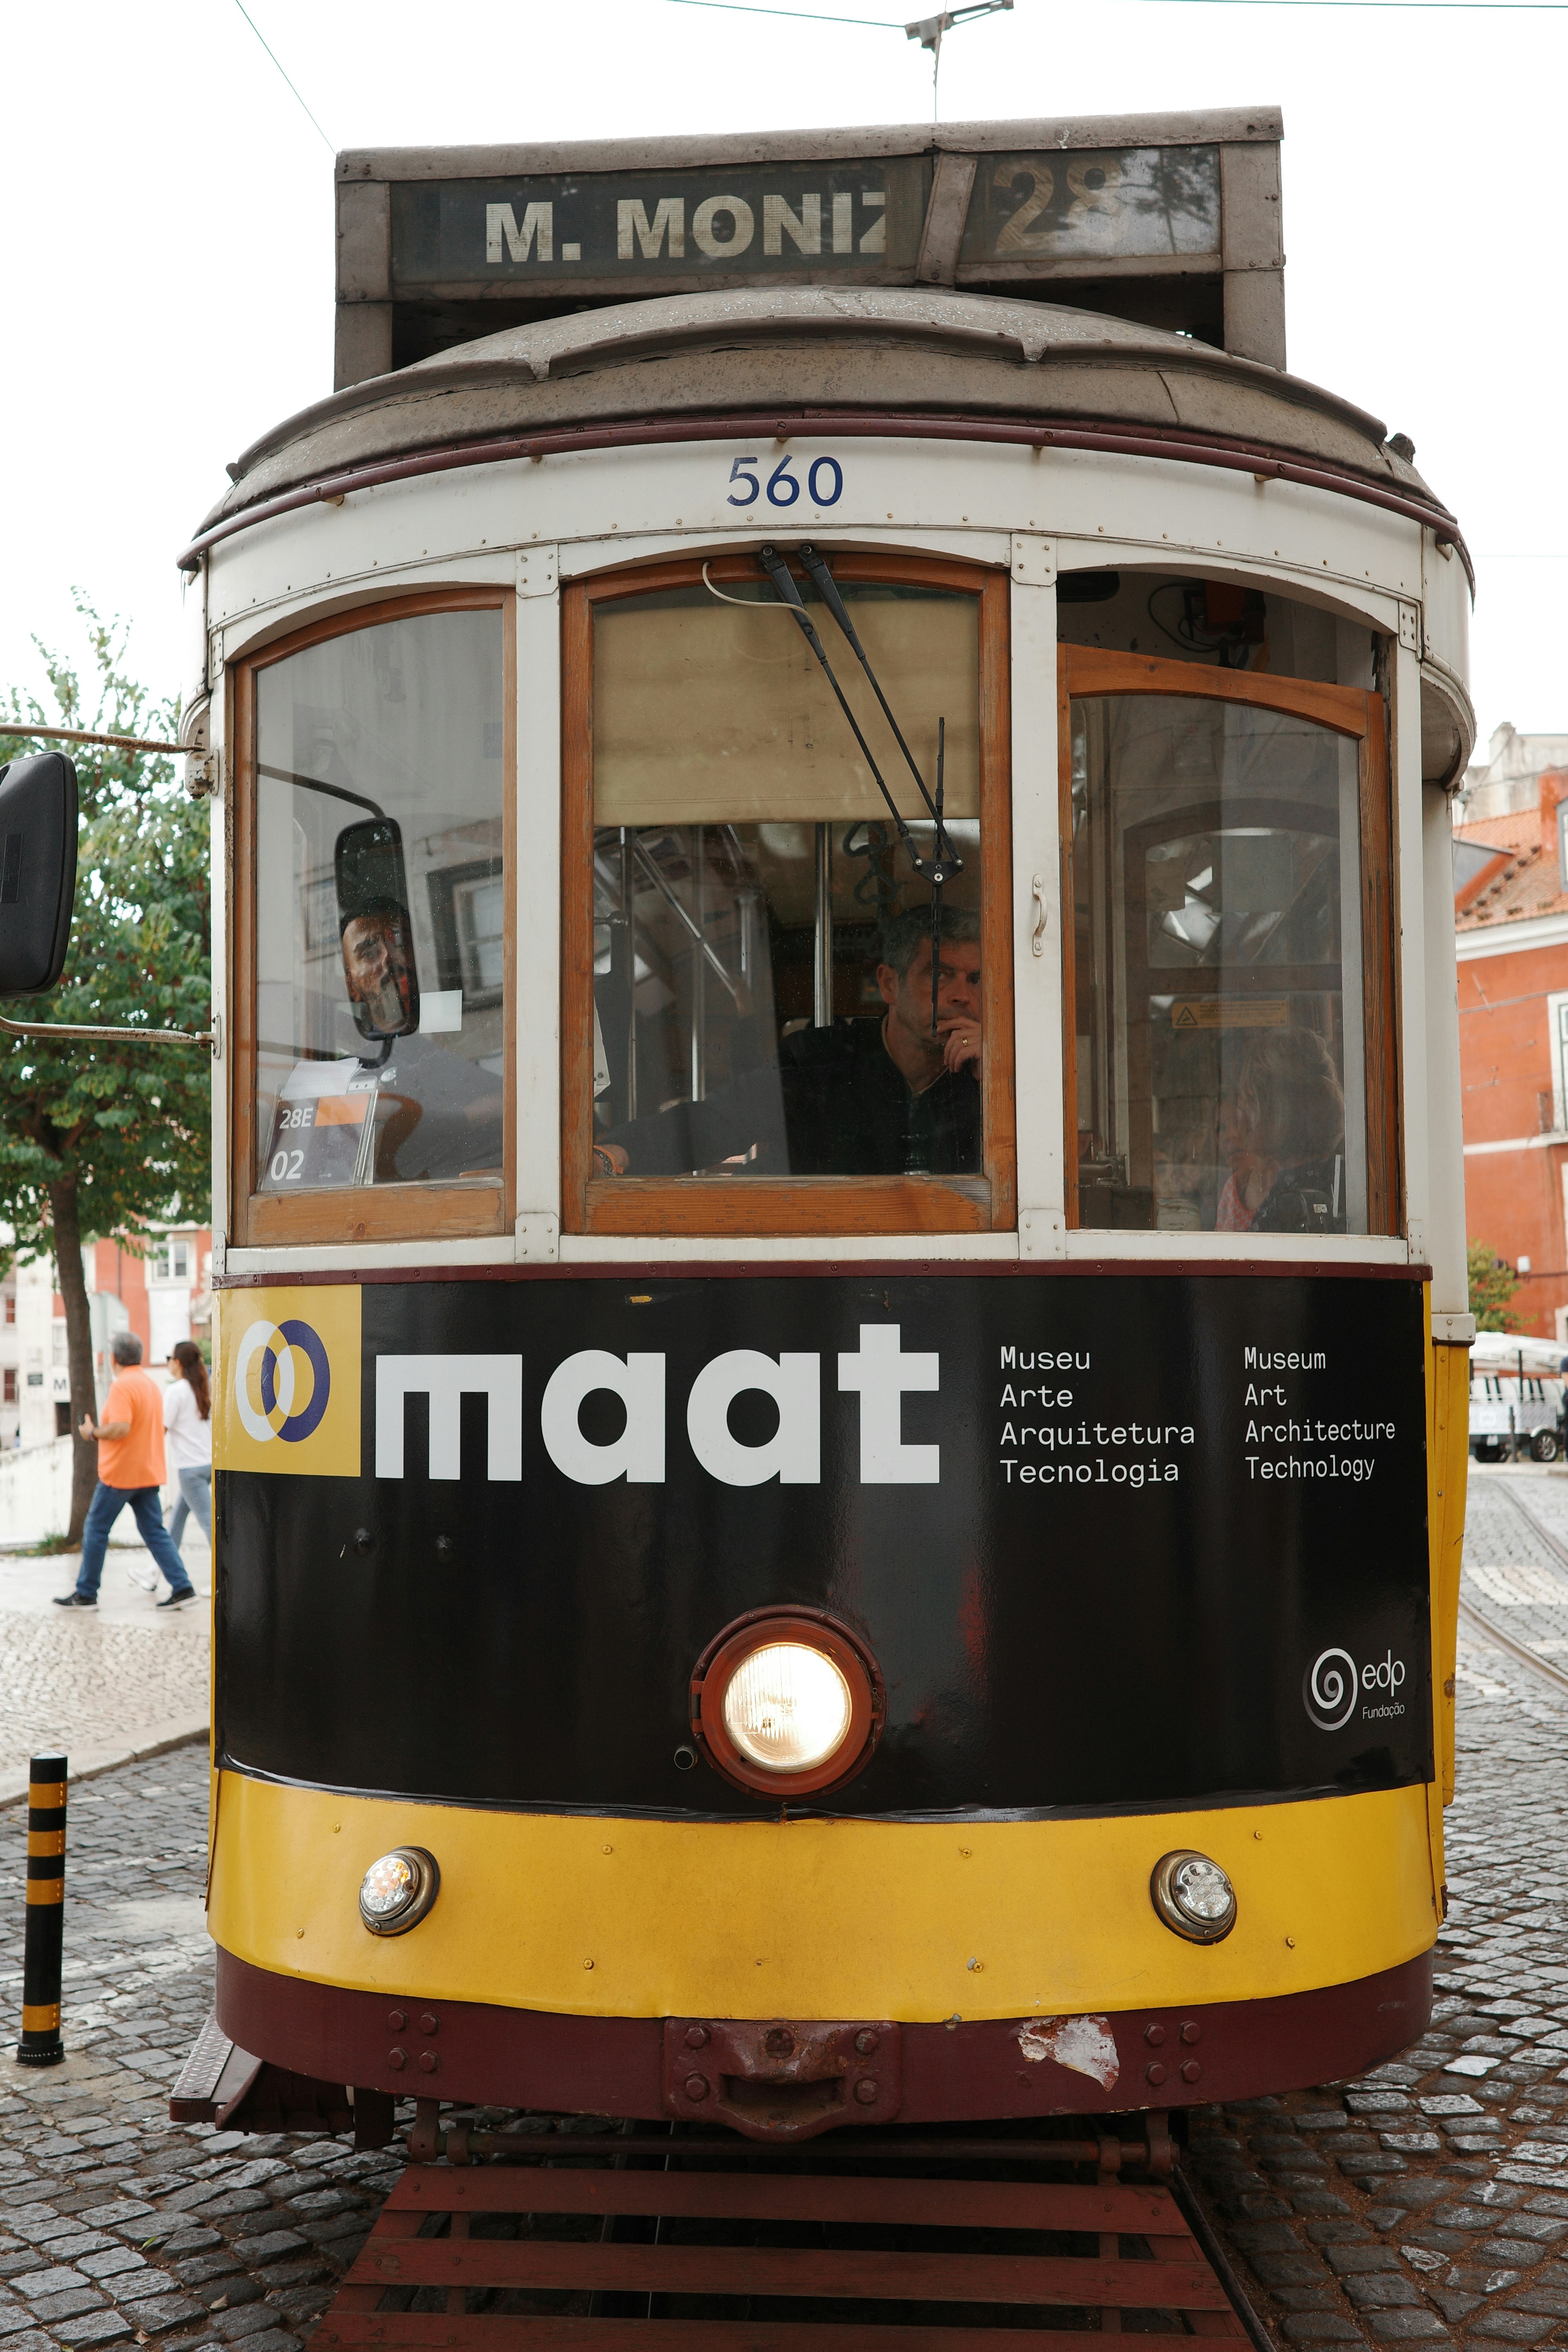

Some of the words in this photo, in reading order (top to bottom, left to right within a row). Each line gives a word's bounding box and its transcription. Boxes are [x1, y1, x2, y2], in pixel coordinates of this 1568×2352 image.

[993, 158, 1129, 252] 28
[486, 201, 581, 263] M.
[726, 455, 843, 507] 560
[279, 1107, 314, 1129] 28E
[270, 1149, 305, 1181] 02
[1000, 1346, 1091, 1370] Museu
[1244, 1347, 1327, 1370] Museum
[375, 1324, 940, 1486] maat
[1000, 1384, 1074, 1407] Arte
[1244, 1383, 1287, 1406] Art
[1000, 1421, 1195, 1451] Arquitetura
[1245, 1419, 1396, 1443] Architecture
[1000, 1458, 1180, 1488] Tecnologia
[1245, 1455, 1376, 1482] Technology
[1361, 1649, 1406, 1697] edp
[1362, 1702, 1405, 1720] Fundação
